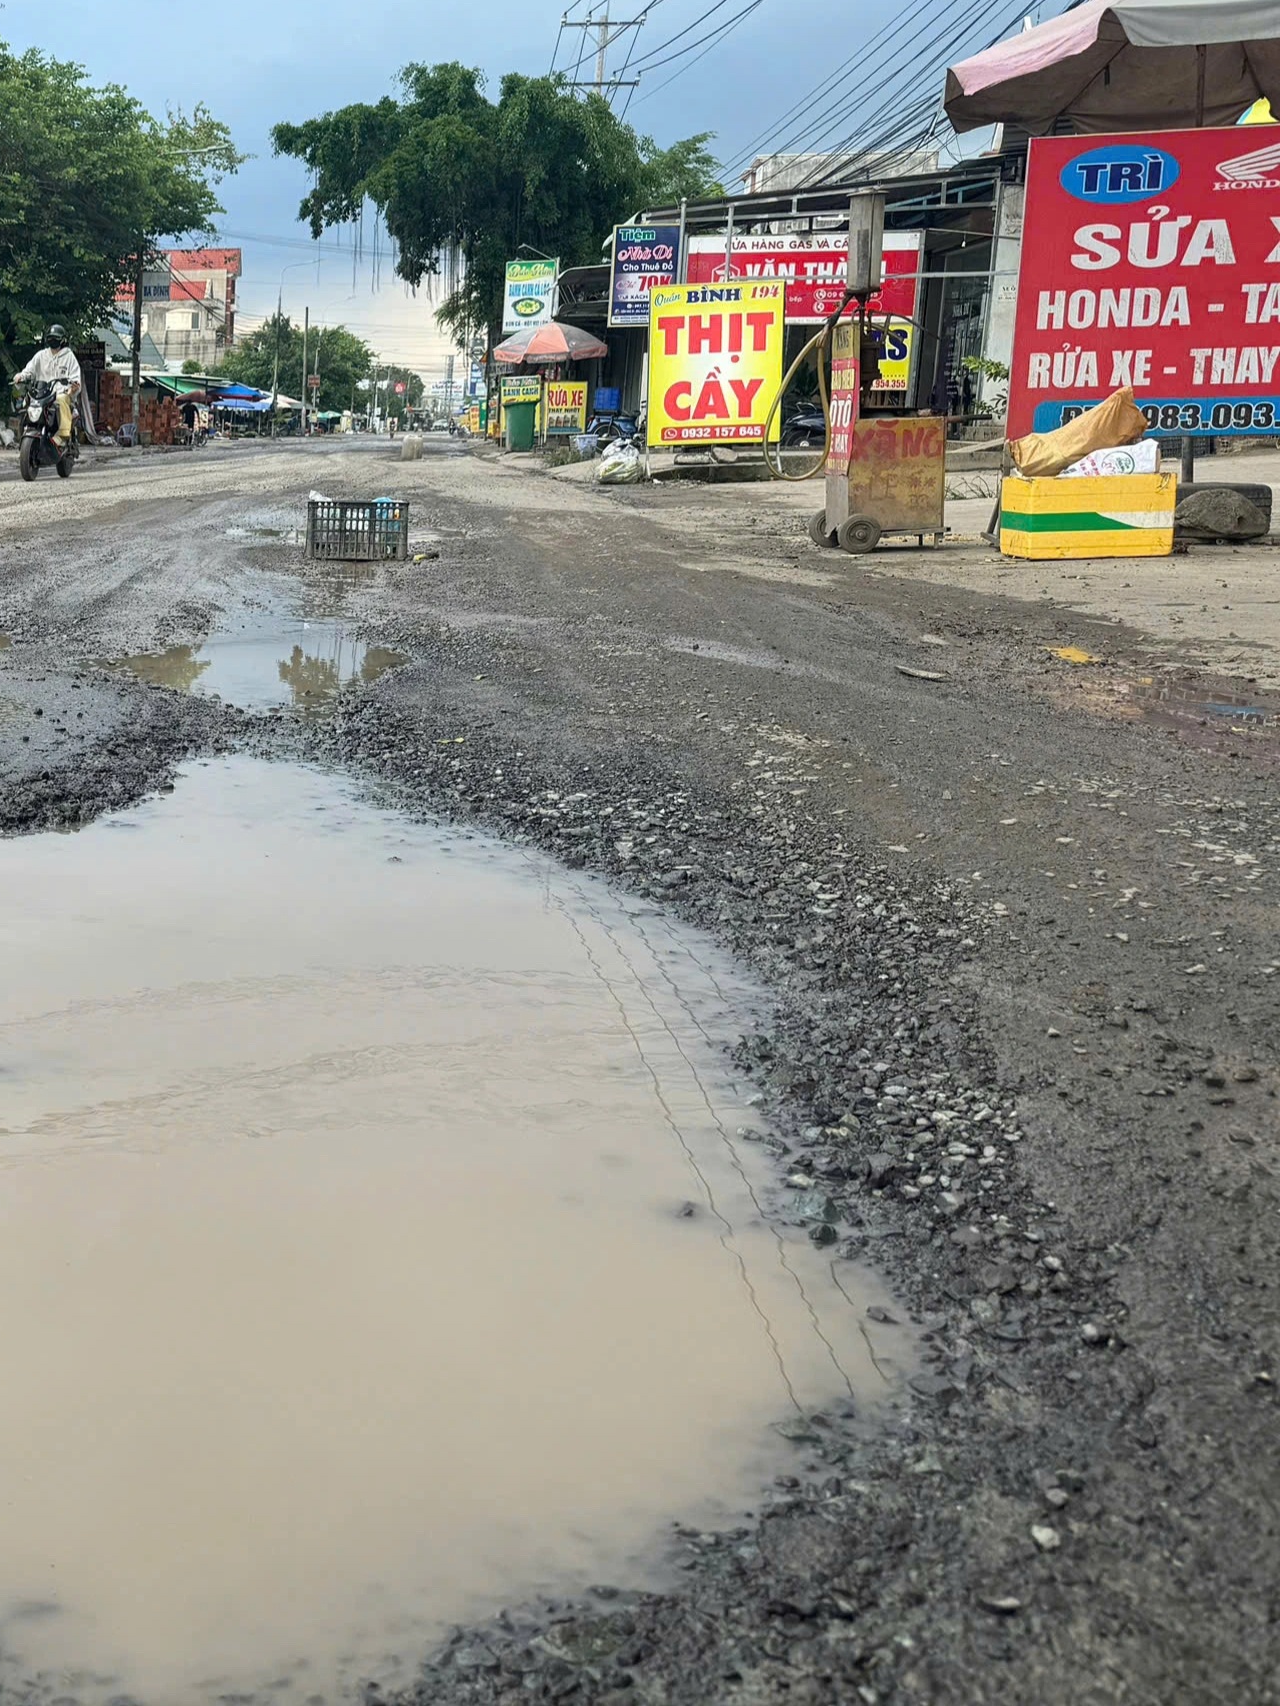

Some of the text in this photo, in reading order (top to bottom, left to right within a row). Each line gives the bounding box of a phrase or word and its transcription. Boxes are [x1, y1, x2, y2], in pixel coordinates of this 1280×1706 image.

[1075, 153, 1166, 195] TRÌ
[1212, 179, 1280, 191] HOND
[619, 228, 656, 243] Tiệm
[751, 239, 784, 250] HÀNG
[789, 240, 813, 249] GAS
[816, 238, 830, 249] VÀ
[833, 237, 849, 248] CÁ
[1071, 205, 1237, 270] SỬA
[622, 263, 639, 272] Cho
[641, 262, 660, 271] Thuê
[746, 257, 887, 286] VĂN THÀ
[654, 284, 780, 307] Quán BÌNH 194
[1036, 287, 1191, 331] HONDA
[657, 311, 774, 364] THỊT
[1027, 342, 1100, 390] RỬA
[1108, 349, 1152, 388] XE
[1190, 345, 1280, 386] THAY
[548, 384, 584, 407] RỬA XE
[663, 366, 765, 422] CẦY
[829, 393, 852, 428] ÔTÔ
[1139, 402, 1280, 430] 983.093.
[681, 426, 761, 438] 0932 157 645
[852, 420, 942, 461] XĂNG
